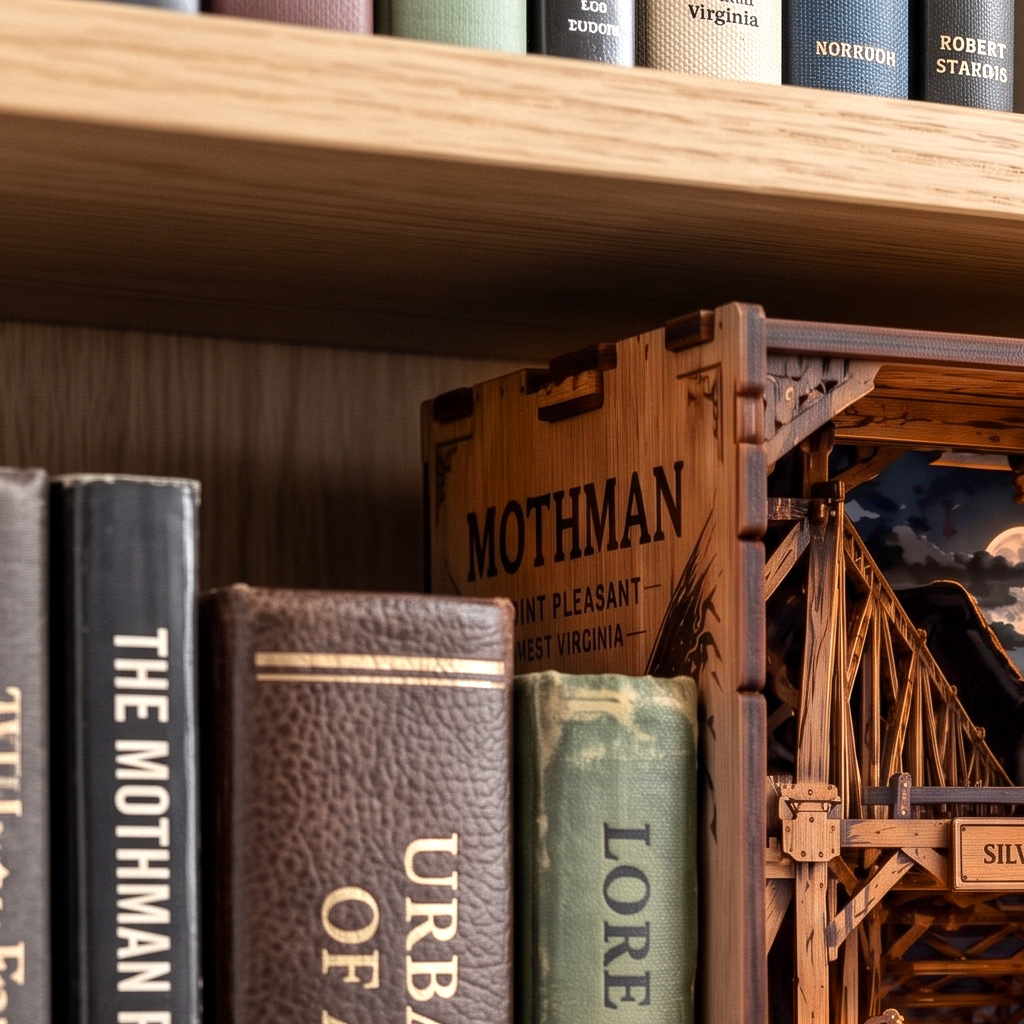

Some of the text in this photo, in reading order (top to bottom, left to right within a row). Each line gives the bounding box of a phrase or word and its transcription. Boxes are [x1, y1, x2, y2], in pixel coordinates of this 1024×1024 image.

[688, 4, 759, 27] Virginia
[940, 35, 1006, 59] ROBERT
[467, 460, 684, 582] MOTHMAN
[553, 577, 641, 619] PLEASANT
[557, 623, 624, 656] VIRGINIA
[112, 628, 169, 723] THE
[114, 739, 171, 993] MOTHMAN
[320, 885, 382, 990] OF
[603, 822, 651, 1010] LORE
